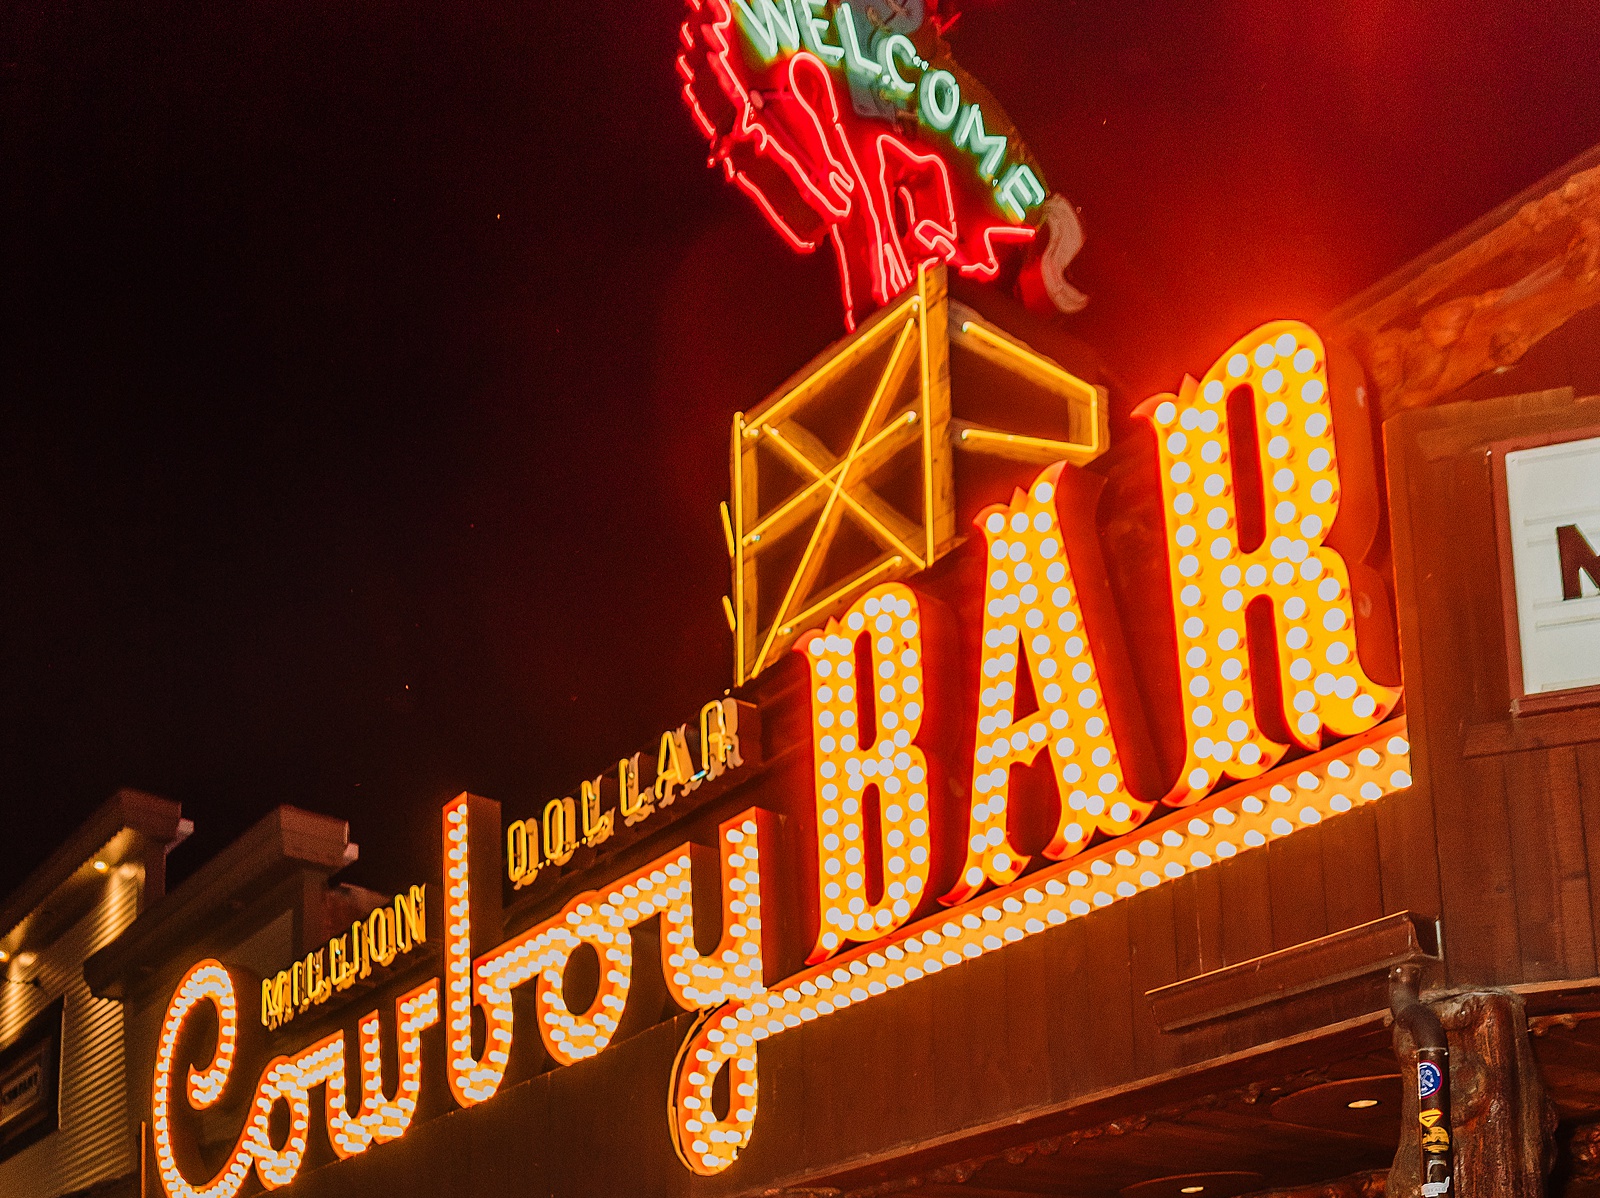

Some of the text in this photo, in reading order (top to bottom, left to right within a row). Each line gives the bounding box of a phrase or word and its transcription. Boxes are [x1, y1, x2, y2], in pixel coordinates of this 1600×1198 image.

[735, 0, 1046, 220] WELCOME
[792, 320, 1403, 965] BAR
[261, 697, 743, 1031] MILLION DOLLAR
